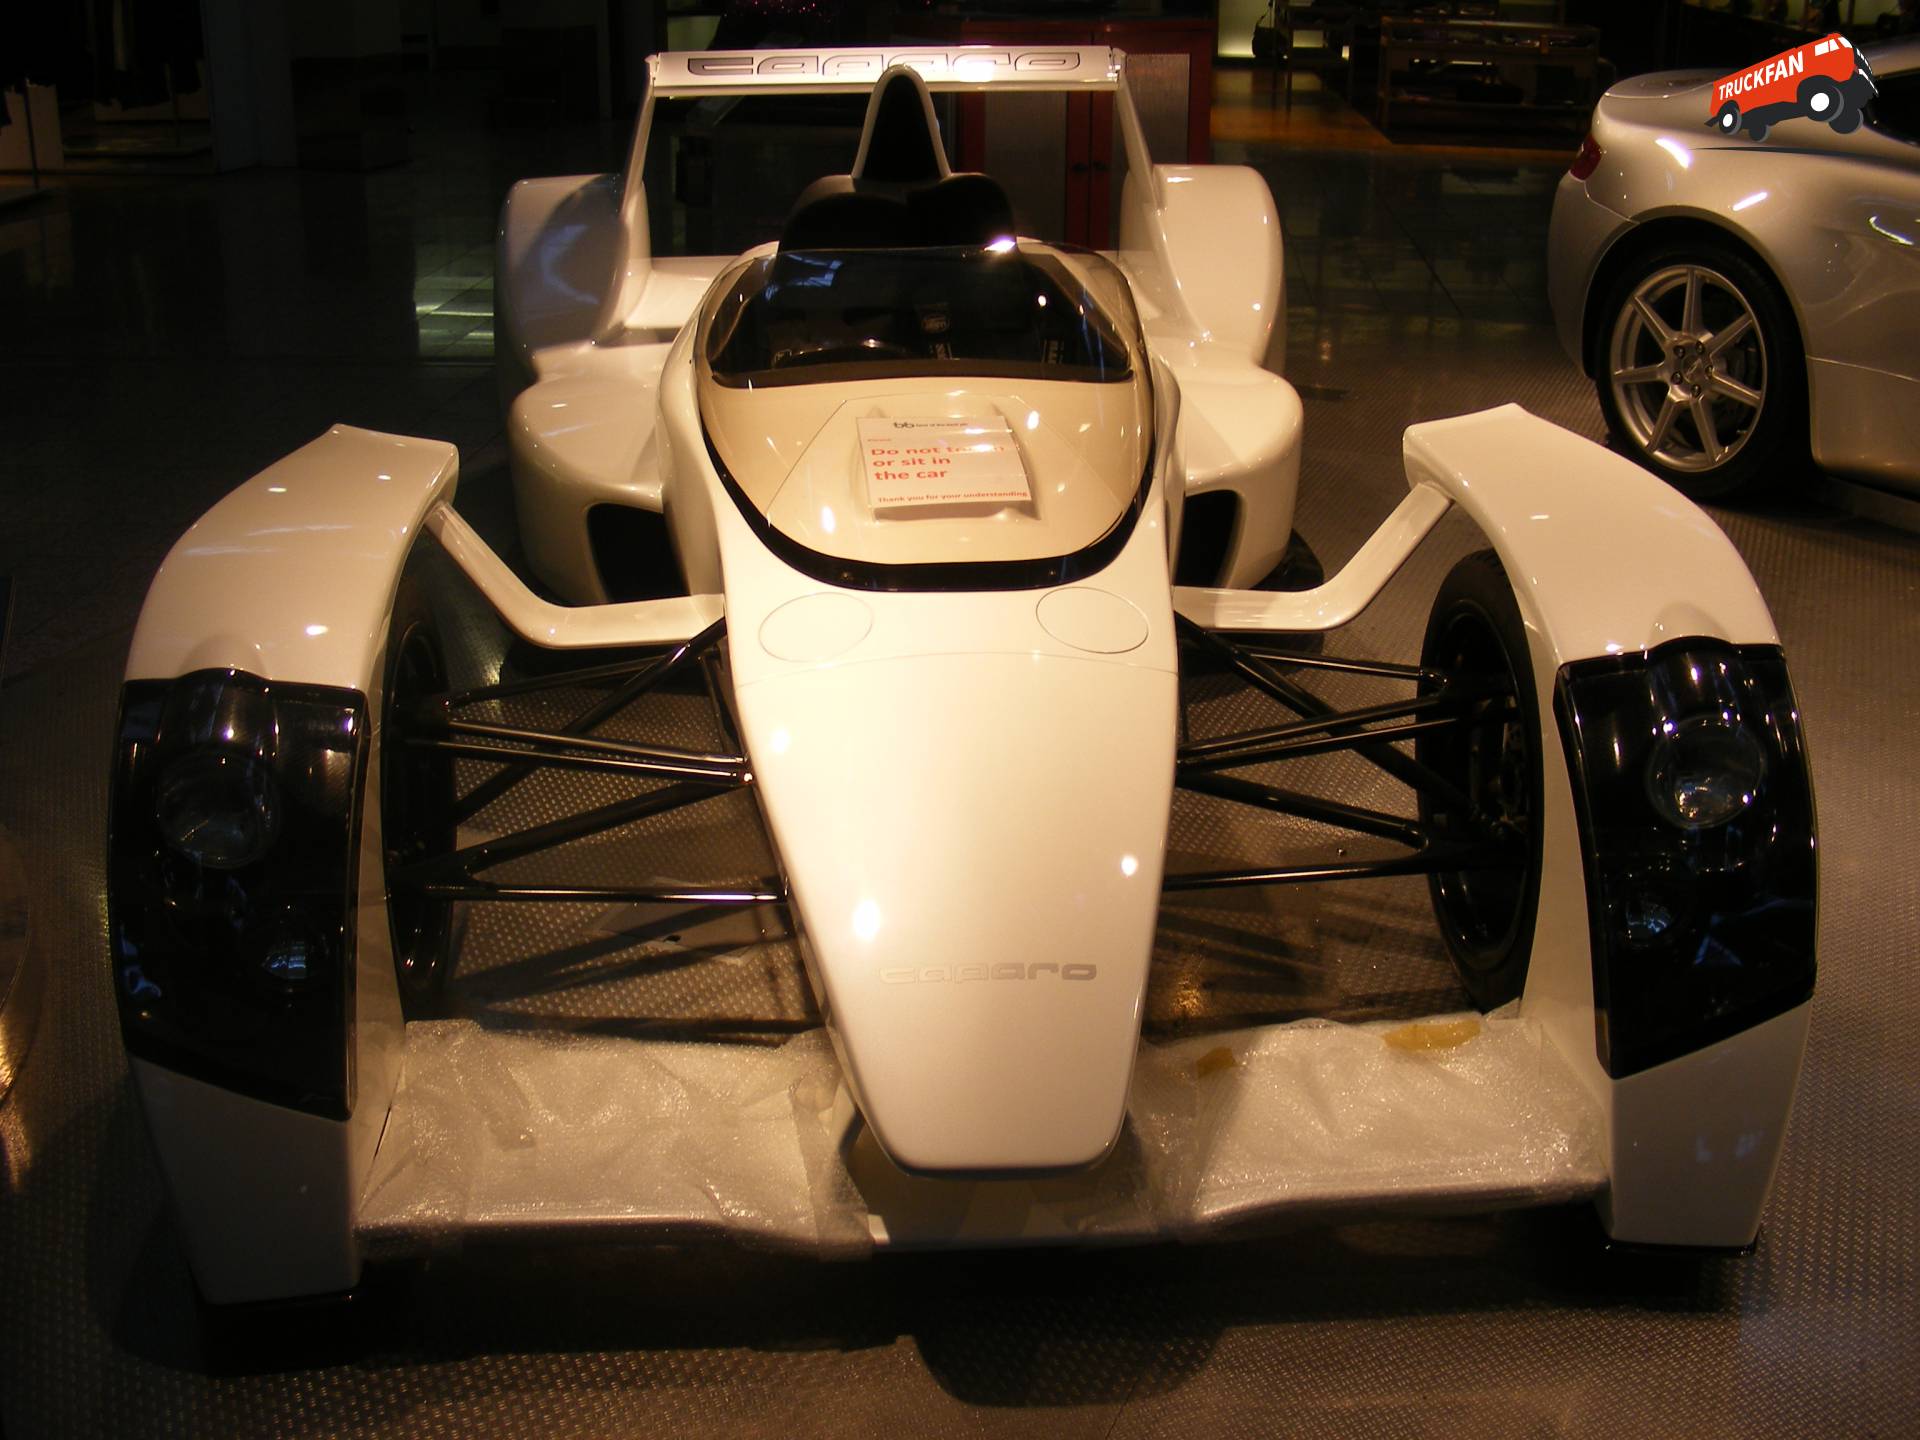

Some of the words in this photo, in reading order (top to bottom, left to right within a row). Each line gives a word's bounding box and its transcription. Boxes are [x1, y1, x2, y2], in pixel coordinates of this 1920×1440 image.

[871, 448, 899, 456] Do
[905, 447, 941, 455] not
[901, 458, 926, 466] sit
[932, 457, 951, 465] in
[874, 471, 909, 481] the
[916, 470, 948, 479] car
[878, 495, 905, 503] Thank
[879, 962, 1098, 984] caparo
